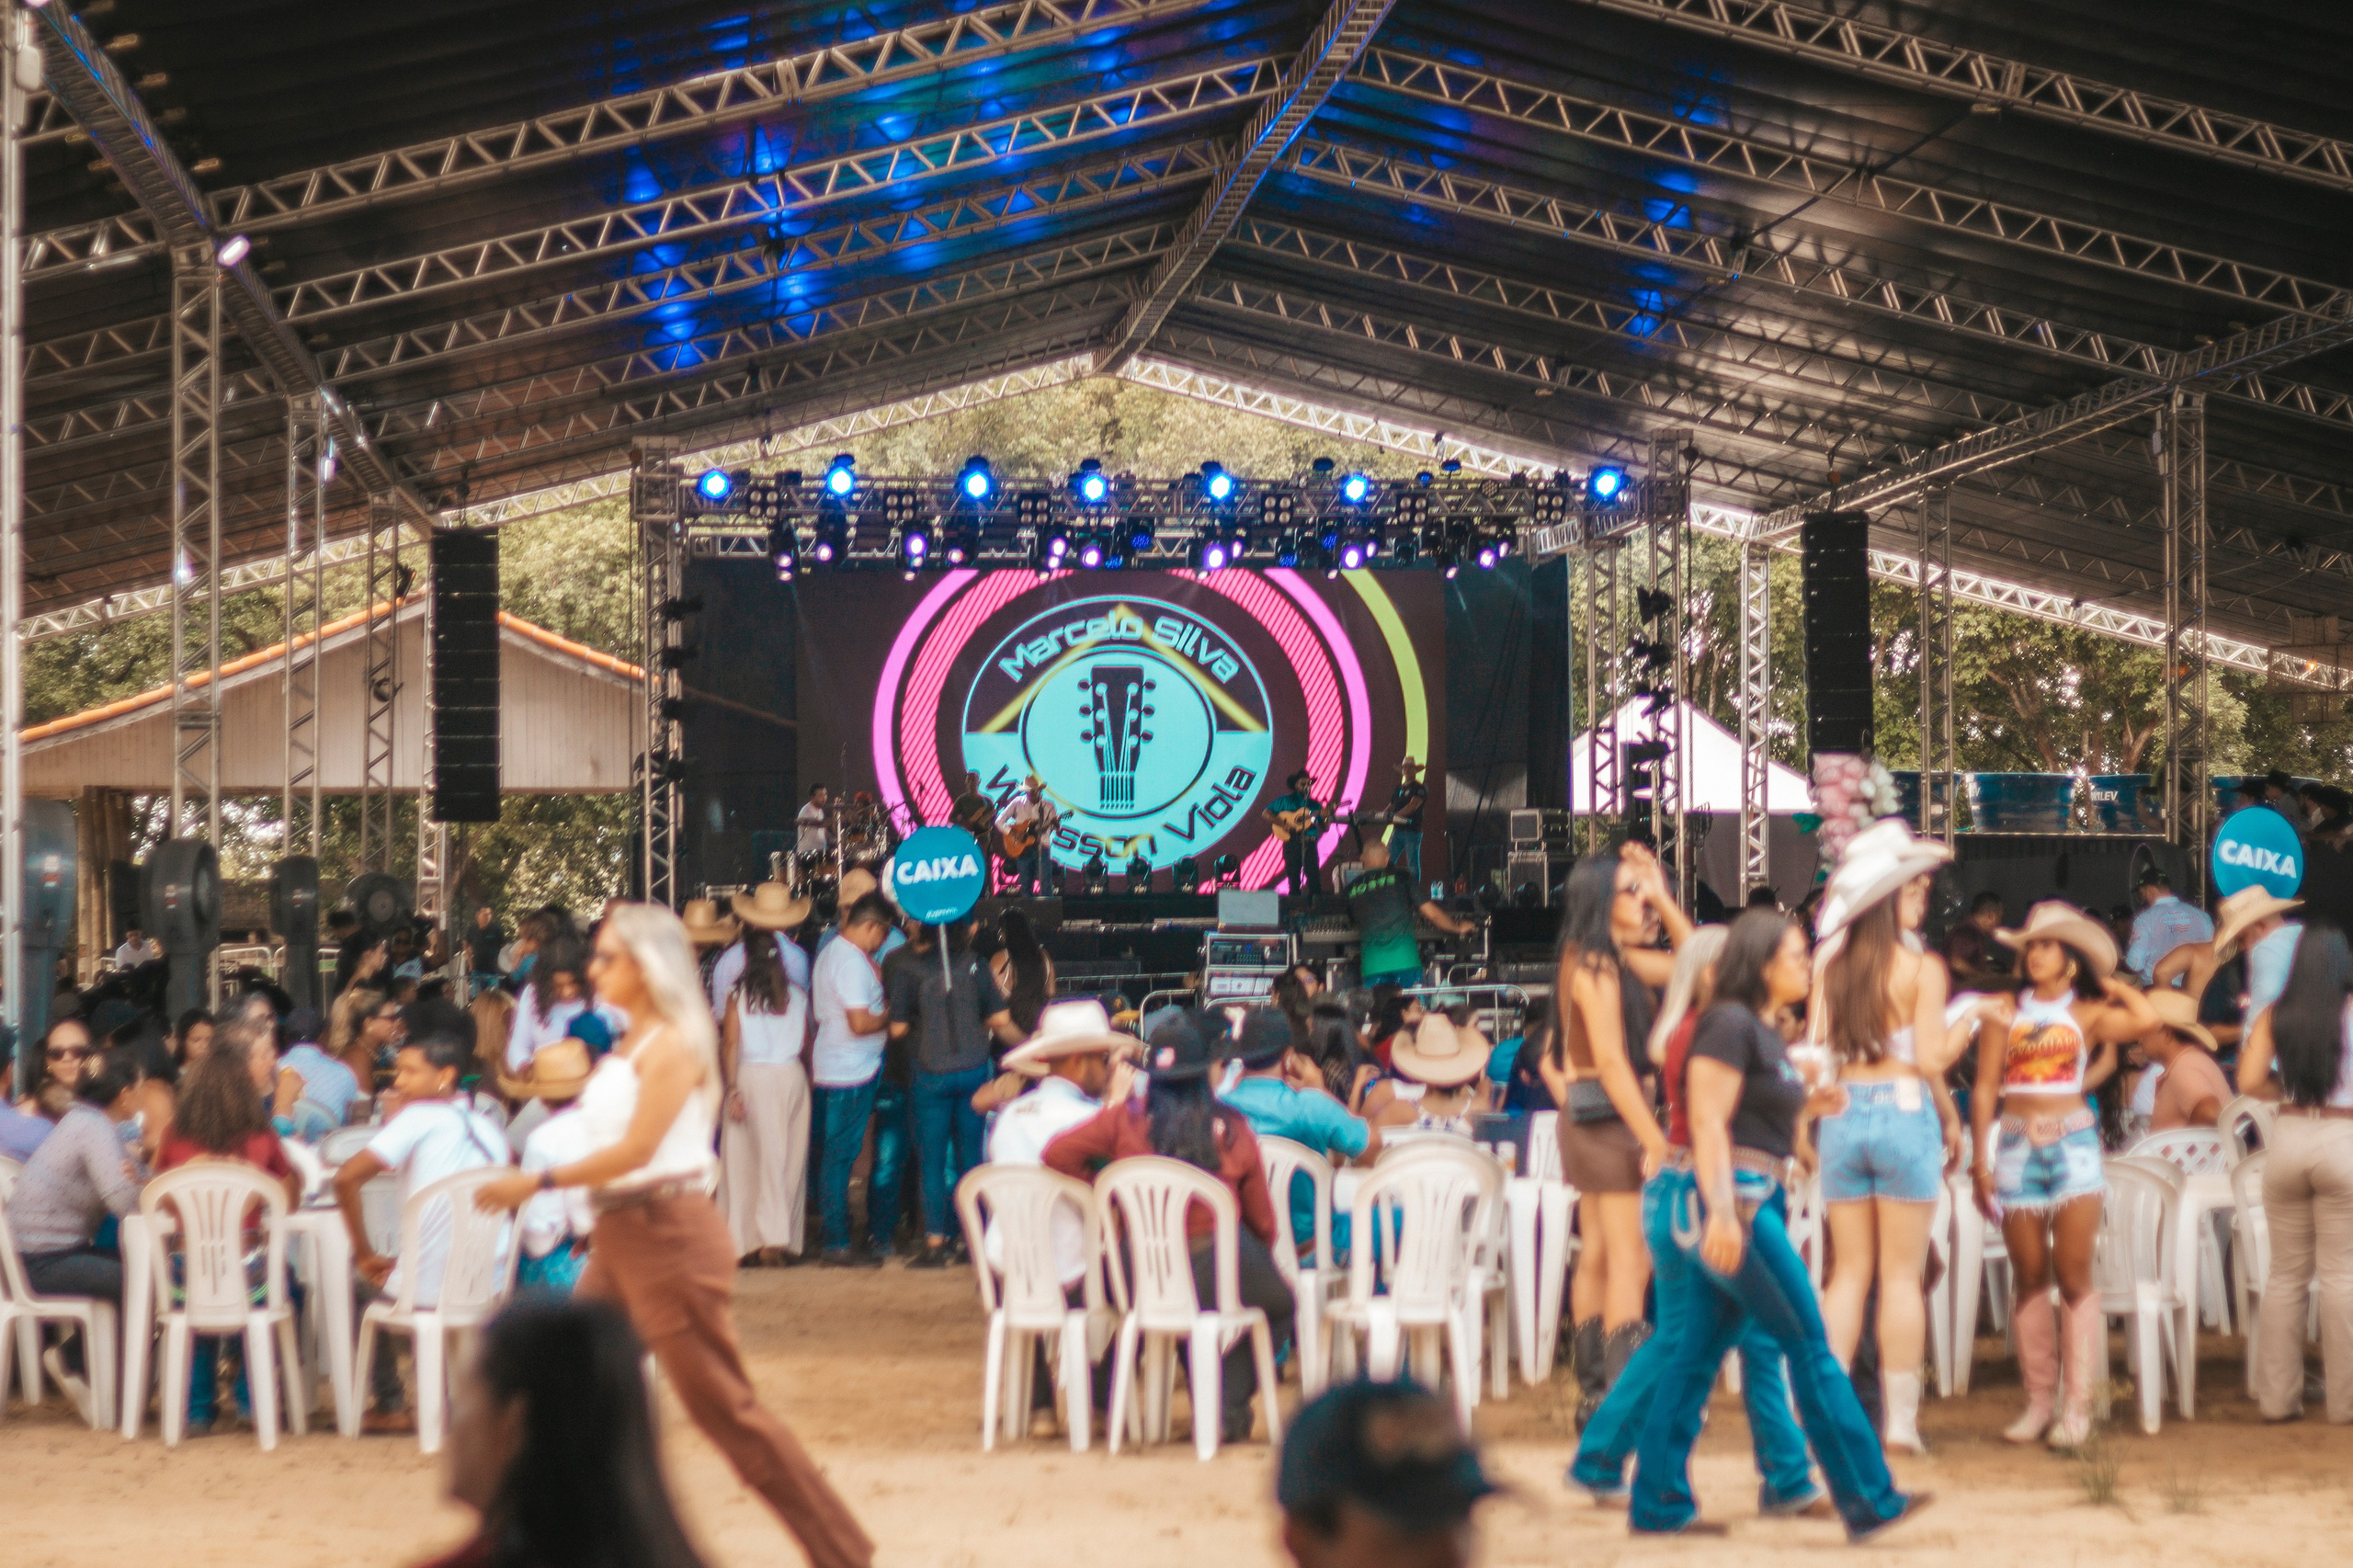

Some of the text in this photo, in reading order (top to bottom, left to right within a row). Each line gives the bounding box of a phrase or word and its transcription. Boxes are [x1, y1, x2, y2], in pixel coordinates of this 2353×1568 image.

[998, 610, 1240, 683] Marcelo Silva
[1162, 765, 1256, 841] Viola
[896, 854, 979, 885] CAIXA
[2220, 838, 2297, 879] CAIXA
